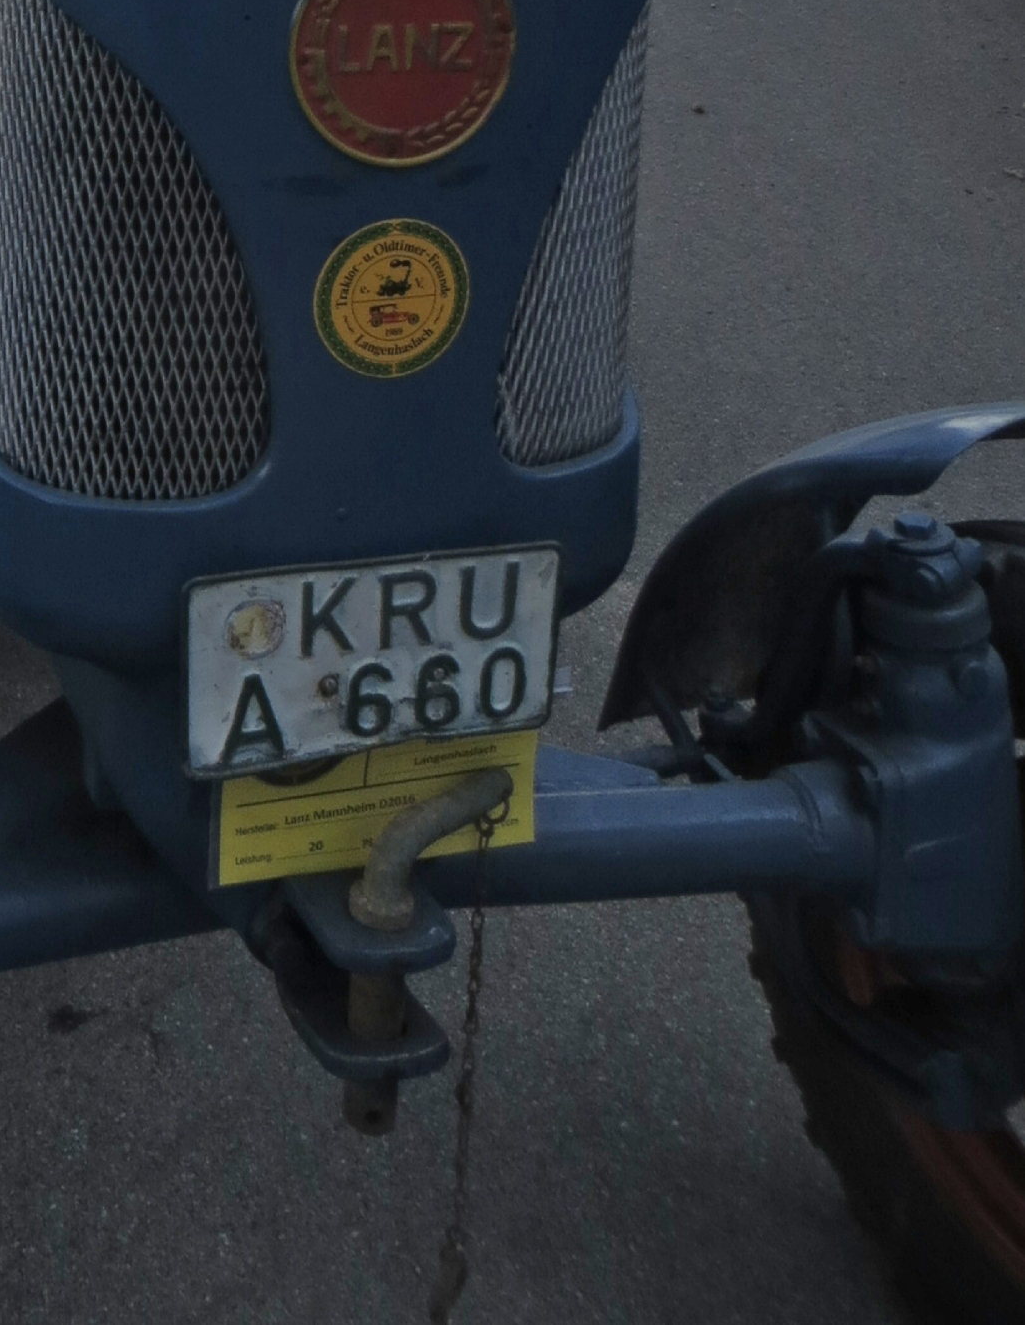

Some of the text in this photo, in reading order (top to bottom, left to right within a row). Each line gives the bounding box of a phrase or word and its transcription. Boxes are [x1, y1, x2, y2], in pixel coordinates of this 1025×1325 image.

[336, 22, 476, 74] LANZ
[353, 326, 435, 357] Langenhaslach
[300, 560, 521, 659] KRU
[219, 646, 527, 770] A 660
[283, 809, 311, 826] Lanz
[312, 800, 377, 822] Mannheim
[378, 792, 417, 810] D2016
[308, 838, 326, 853] 20
